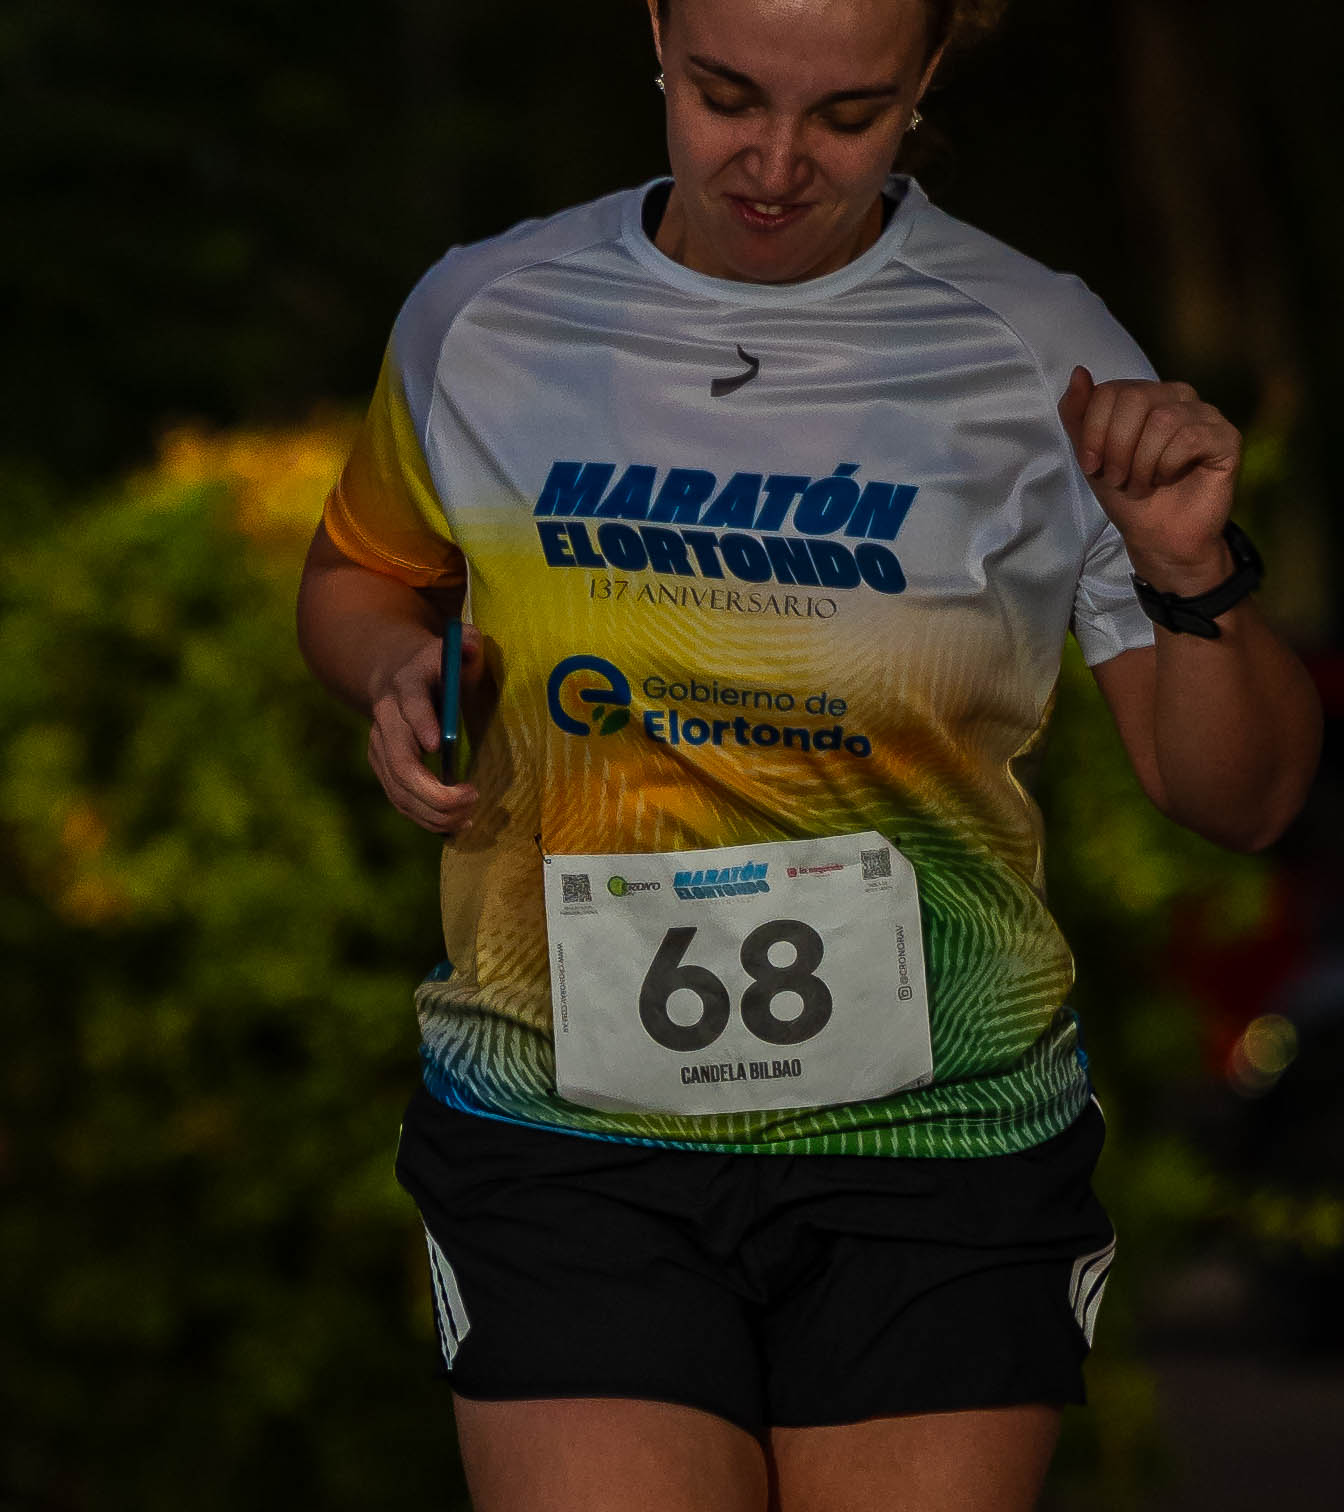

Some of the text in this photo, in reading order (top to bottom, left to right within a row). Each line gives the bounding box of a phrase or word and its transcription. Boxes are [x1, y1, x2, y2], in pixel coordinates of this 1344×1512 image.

[533, 462, 919, 541] MARATÓN
[535, 521, 908, 595] ELORTONDO
[589, 578, 838, 619] 137 ANIVERSARIO
[642, 676, 848, 716] Gobierno de
[643, 709, 873, 758] Elortondo
[638, 919, 833, 1052] 68
[680, 1058, 802, 1085] CANDELA BILBAO
